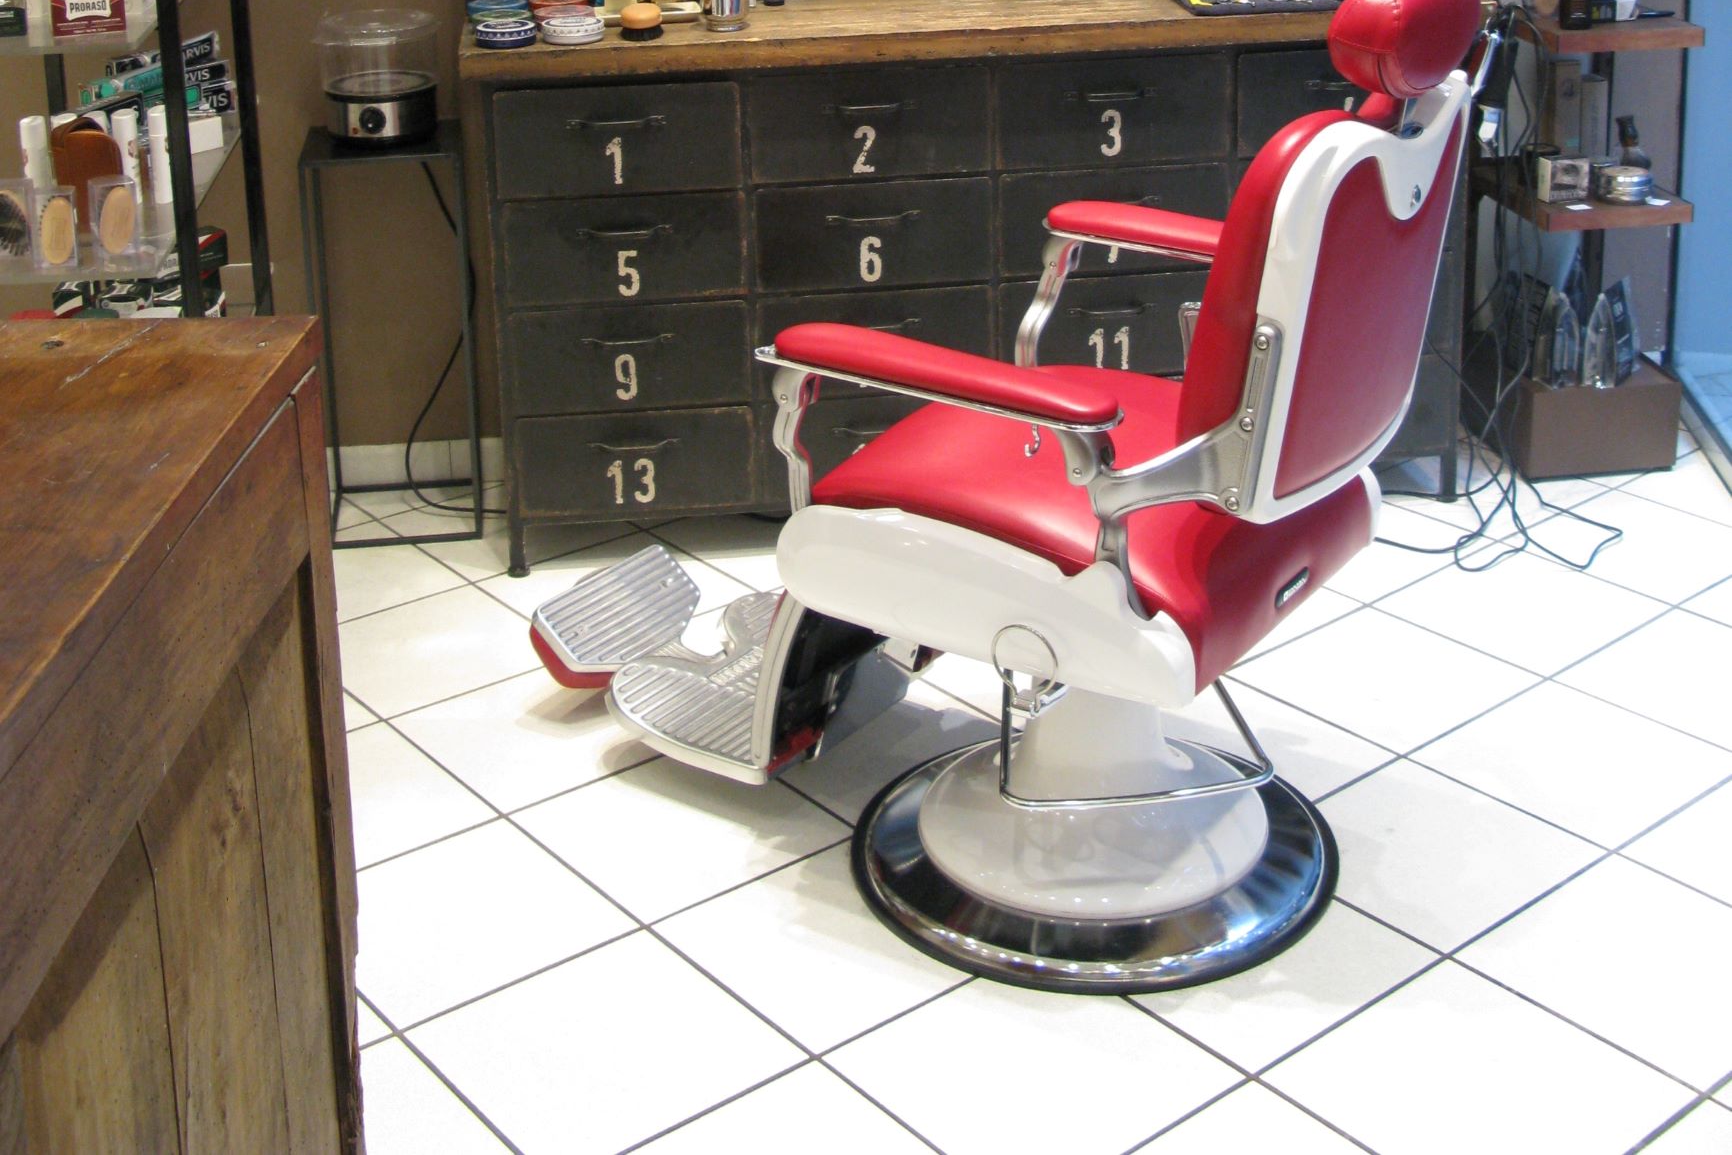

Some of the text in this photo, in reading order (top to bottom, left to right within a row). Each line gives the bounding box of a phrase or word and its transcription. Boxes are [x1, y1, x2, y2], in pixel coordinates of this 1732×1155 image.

[70, 0, 107, 14] PRORASO
[183, 42, 211, 59] RVIS
[852, 125, 876, 174] 2
[1100, 109, 1122, 157] 3
[605, 136, 624, 185] 1
[617, 250, 640, 297] 5
[859, 236, 882, 282] 6
[1088, 326, 1129, 370] 11
[614, 354, 638, 401] 9
[606, 458, 655, 504] 13
